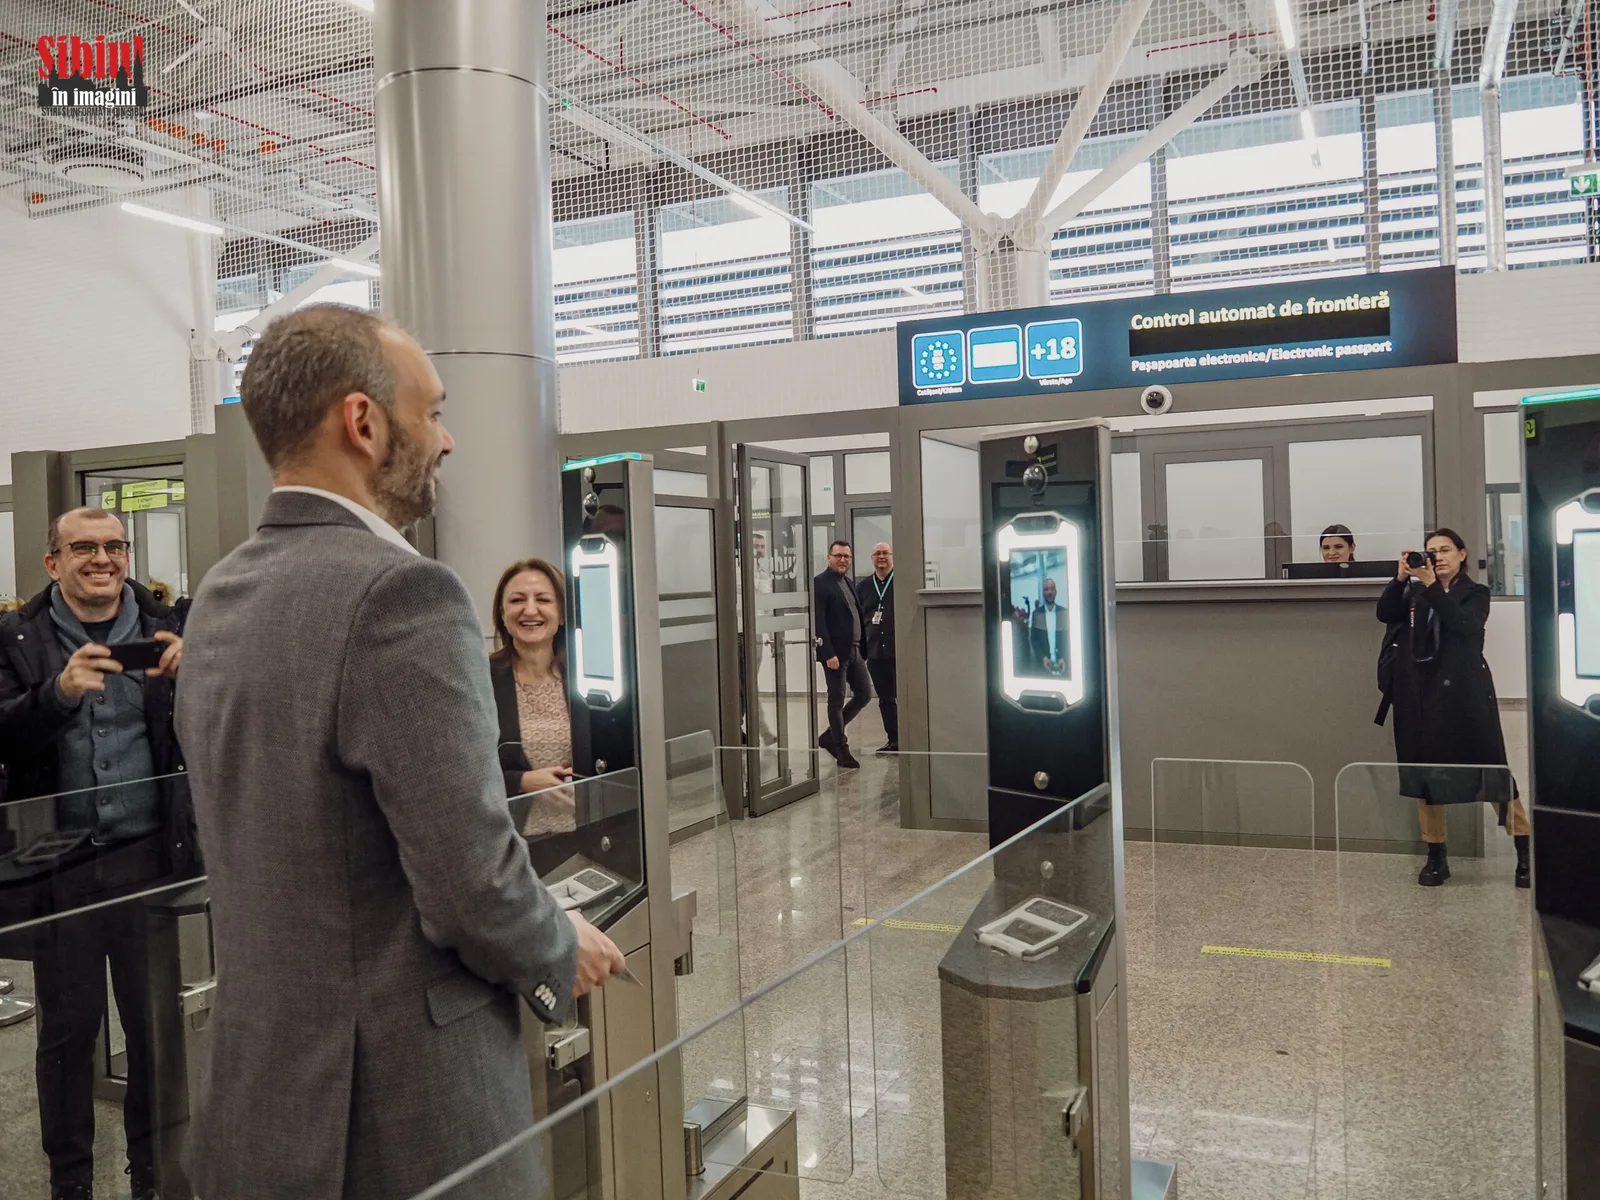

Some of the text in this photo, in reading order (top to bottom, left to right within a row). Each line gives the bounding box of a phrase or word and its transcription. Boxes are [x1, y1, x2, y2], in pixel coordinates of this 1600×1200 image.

[1130, 290, 1391, 330] Control automat de frontieră
[1029, 336, 1077, 361] +18
[1198, 344, 1334, 367] electronice/Electronic
[1335, 340, 1393, 359] passport
